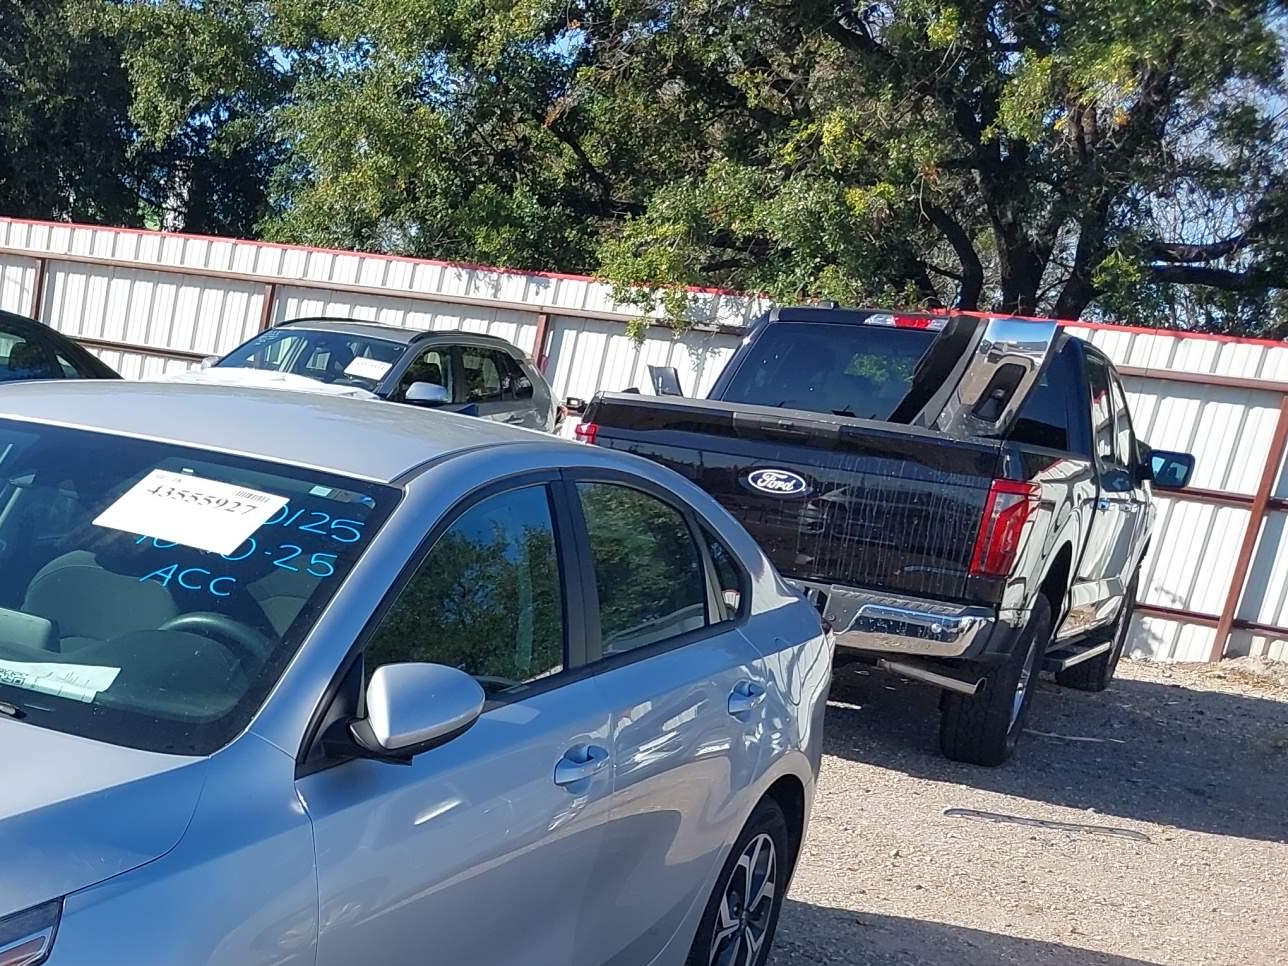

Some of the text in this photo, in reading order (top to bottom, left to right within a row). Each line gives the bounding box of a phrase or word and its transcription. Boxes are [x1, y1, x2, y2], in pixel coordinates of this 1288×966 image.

[755, 471, 798, 492] Ford
[147, 484, 257, 516] 43555927
[139, 564, 237, 596] ACC
